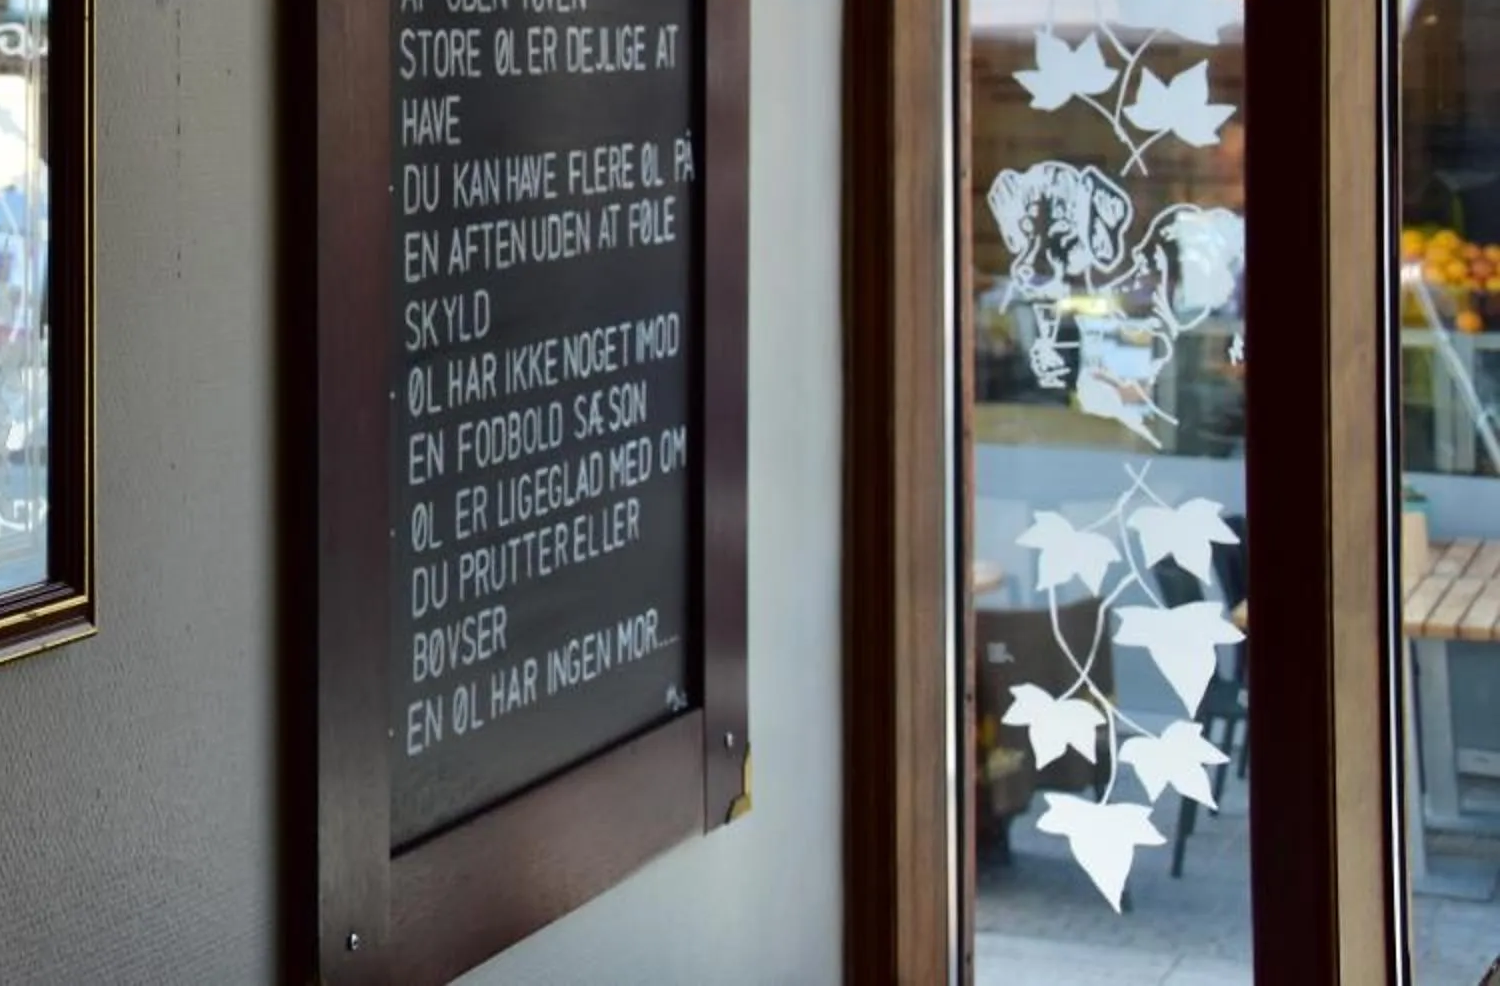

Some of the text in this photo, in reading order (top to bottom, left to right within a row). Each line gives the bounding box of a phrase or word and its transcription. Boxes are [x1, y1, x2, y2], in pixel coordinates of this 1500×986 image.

[400, 23, 679, 80] STORE ØL ER DEJLIGE AT
[402, 94, 462, 148] HAVE
[403, 164, 440, 216] DU
[452, 158, 500, 210] KAN
[505, 151, 558, 204] HAVE
[568, 142, 635, 196] FLERE
[640, 140, 665, 189] ØL
[404, 195, 676, 284] EN AFTEN UDEN AT FØLE
[407, 366, 442, 418] ØL
[448, 351, 498, 409] HAR
[504, 337, 559, 395] IKKE
[562, 320, 632, 381] NOGET
[408, 429, 445, 487] EN
[456, 401, 564, 472] FODBOLD
[411, 424, 688, 553] ØL ER LIGEGLAD MED OM
[411, 497, 641, 620] DU PRUTTER ELLER
[412, 604, 508, 684] BØVSER
[406, 694, 444, 757] EN
[452, 682, 485, 736] ØL
[491, 656, 539, 720] HAR
[546, 628, 612, 696] INGEN
